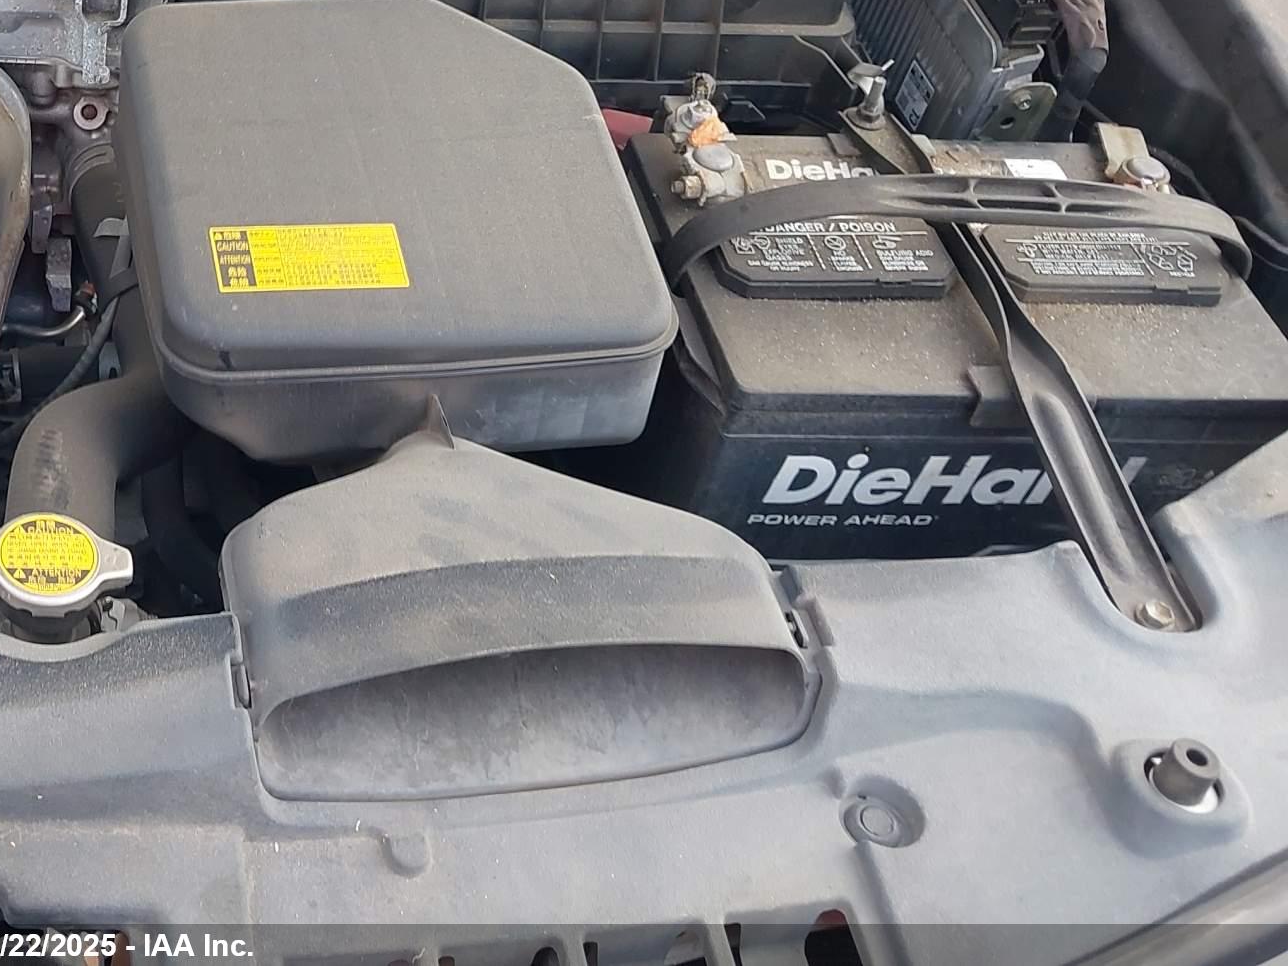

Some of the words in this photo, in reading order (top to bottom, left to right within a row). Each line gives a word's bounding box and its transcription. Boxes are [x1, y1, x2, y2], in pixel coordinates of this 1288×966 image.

[765, 158, 881, 181] DieHa
[839, 223, 897, 232] POISON
[216, 240, 249, 251] CAUTION
[747, 514, 837, 526] POWER
[844, 514, 933, 526] AHEAD
[31, 568, 82, 578] ATTENTION
